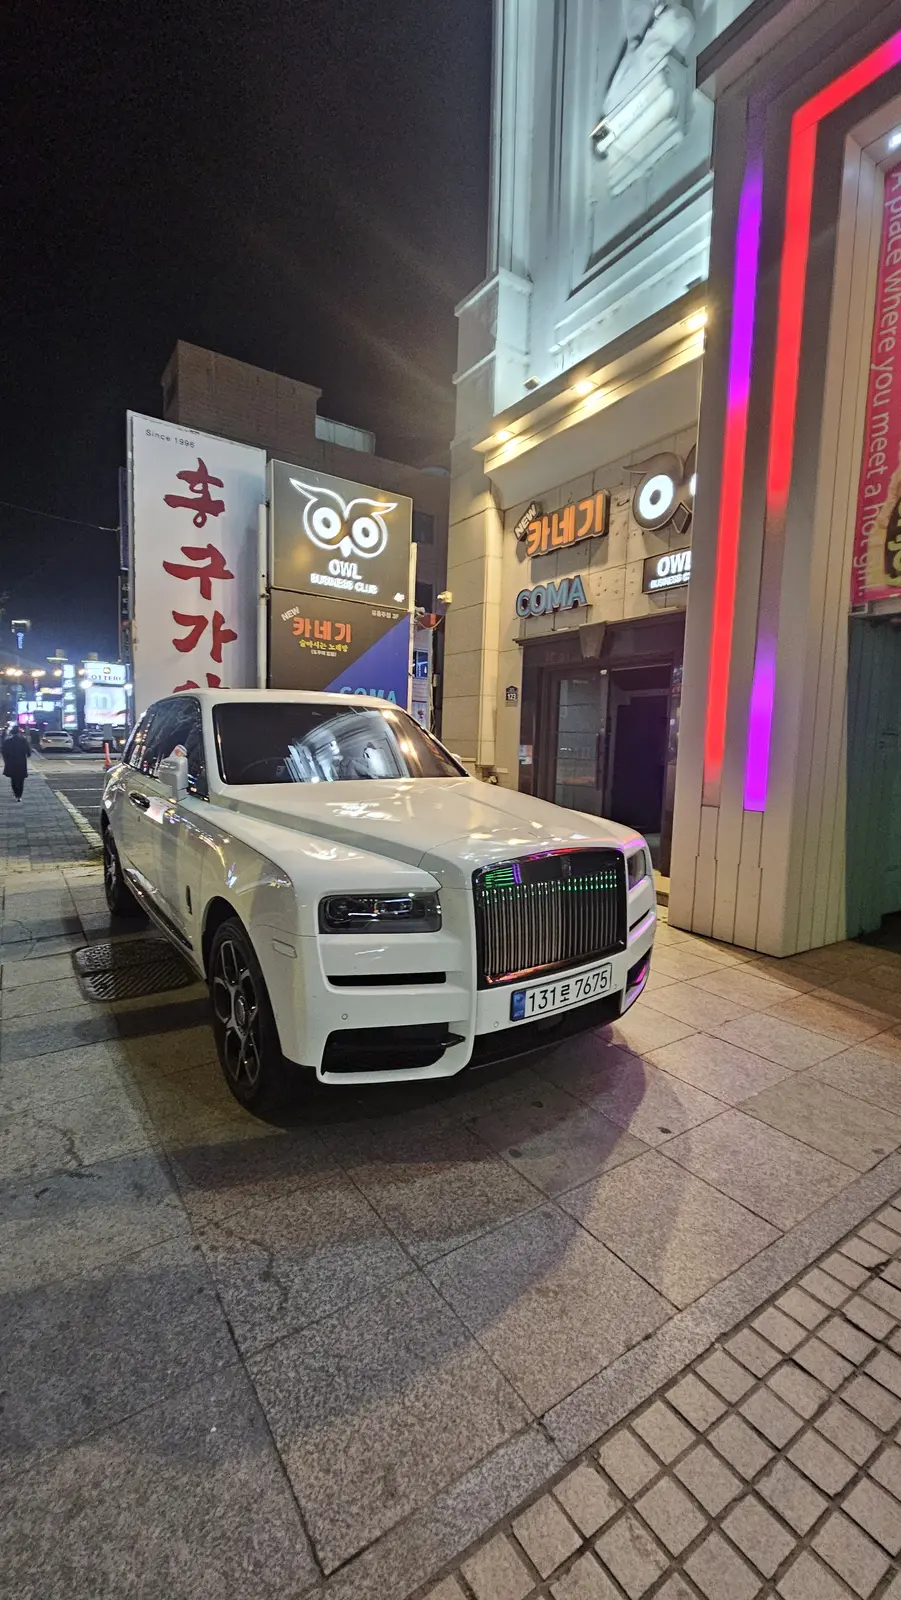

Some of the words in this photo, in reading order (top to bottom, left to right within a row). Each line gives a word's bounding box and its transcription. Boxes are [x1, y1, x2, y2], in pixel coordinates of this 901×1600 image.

[878, 269, 901, 354] where
[871, 356, 895, 407] you
[146, 429, 171, 442] Since
[866, 411, 890, 480] meet
[864, 483, 882, 498] a
[514, 504, 537, 538] NEW
[527, 493, 604, 555] 카네기
[310, 573, 354, 591] BUSINESS
[355, 581, 378, 595] CLUB
[328, 558, 363, 580] OWL
[516, 575, 588, 618] COMA
[280, 606, 300, 621] NEW
[292, 616, 352, 643] 카네기
